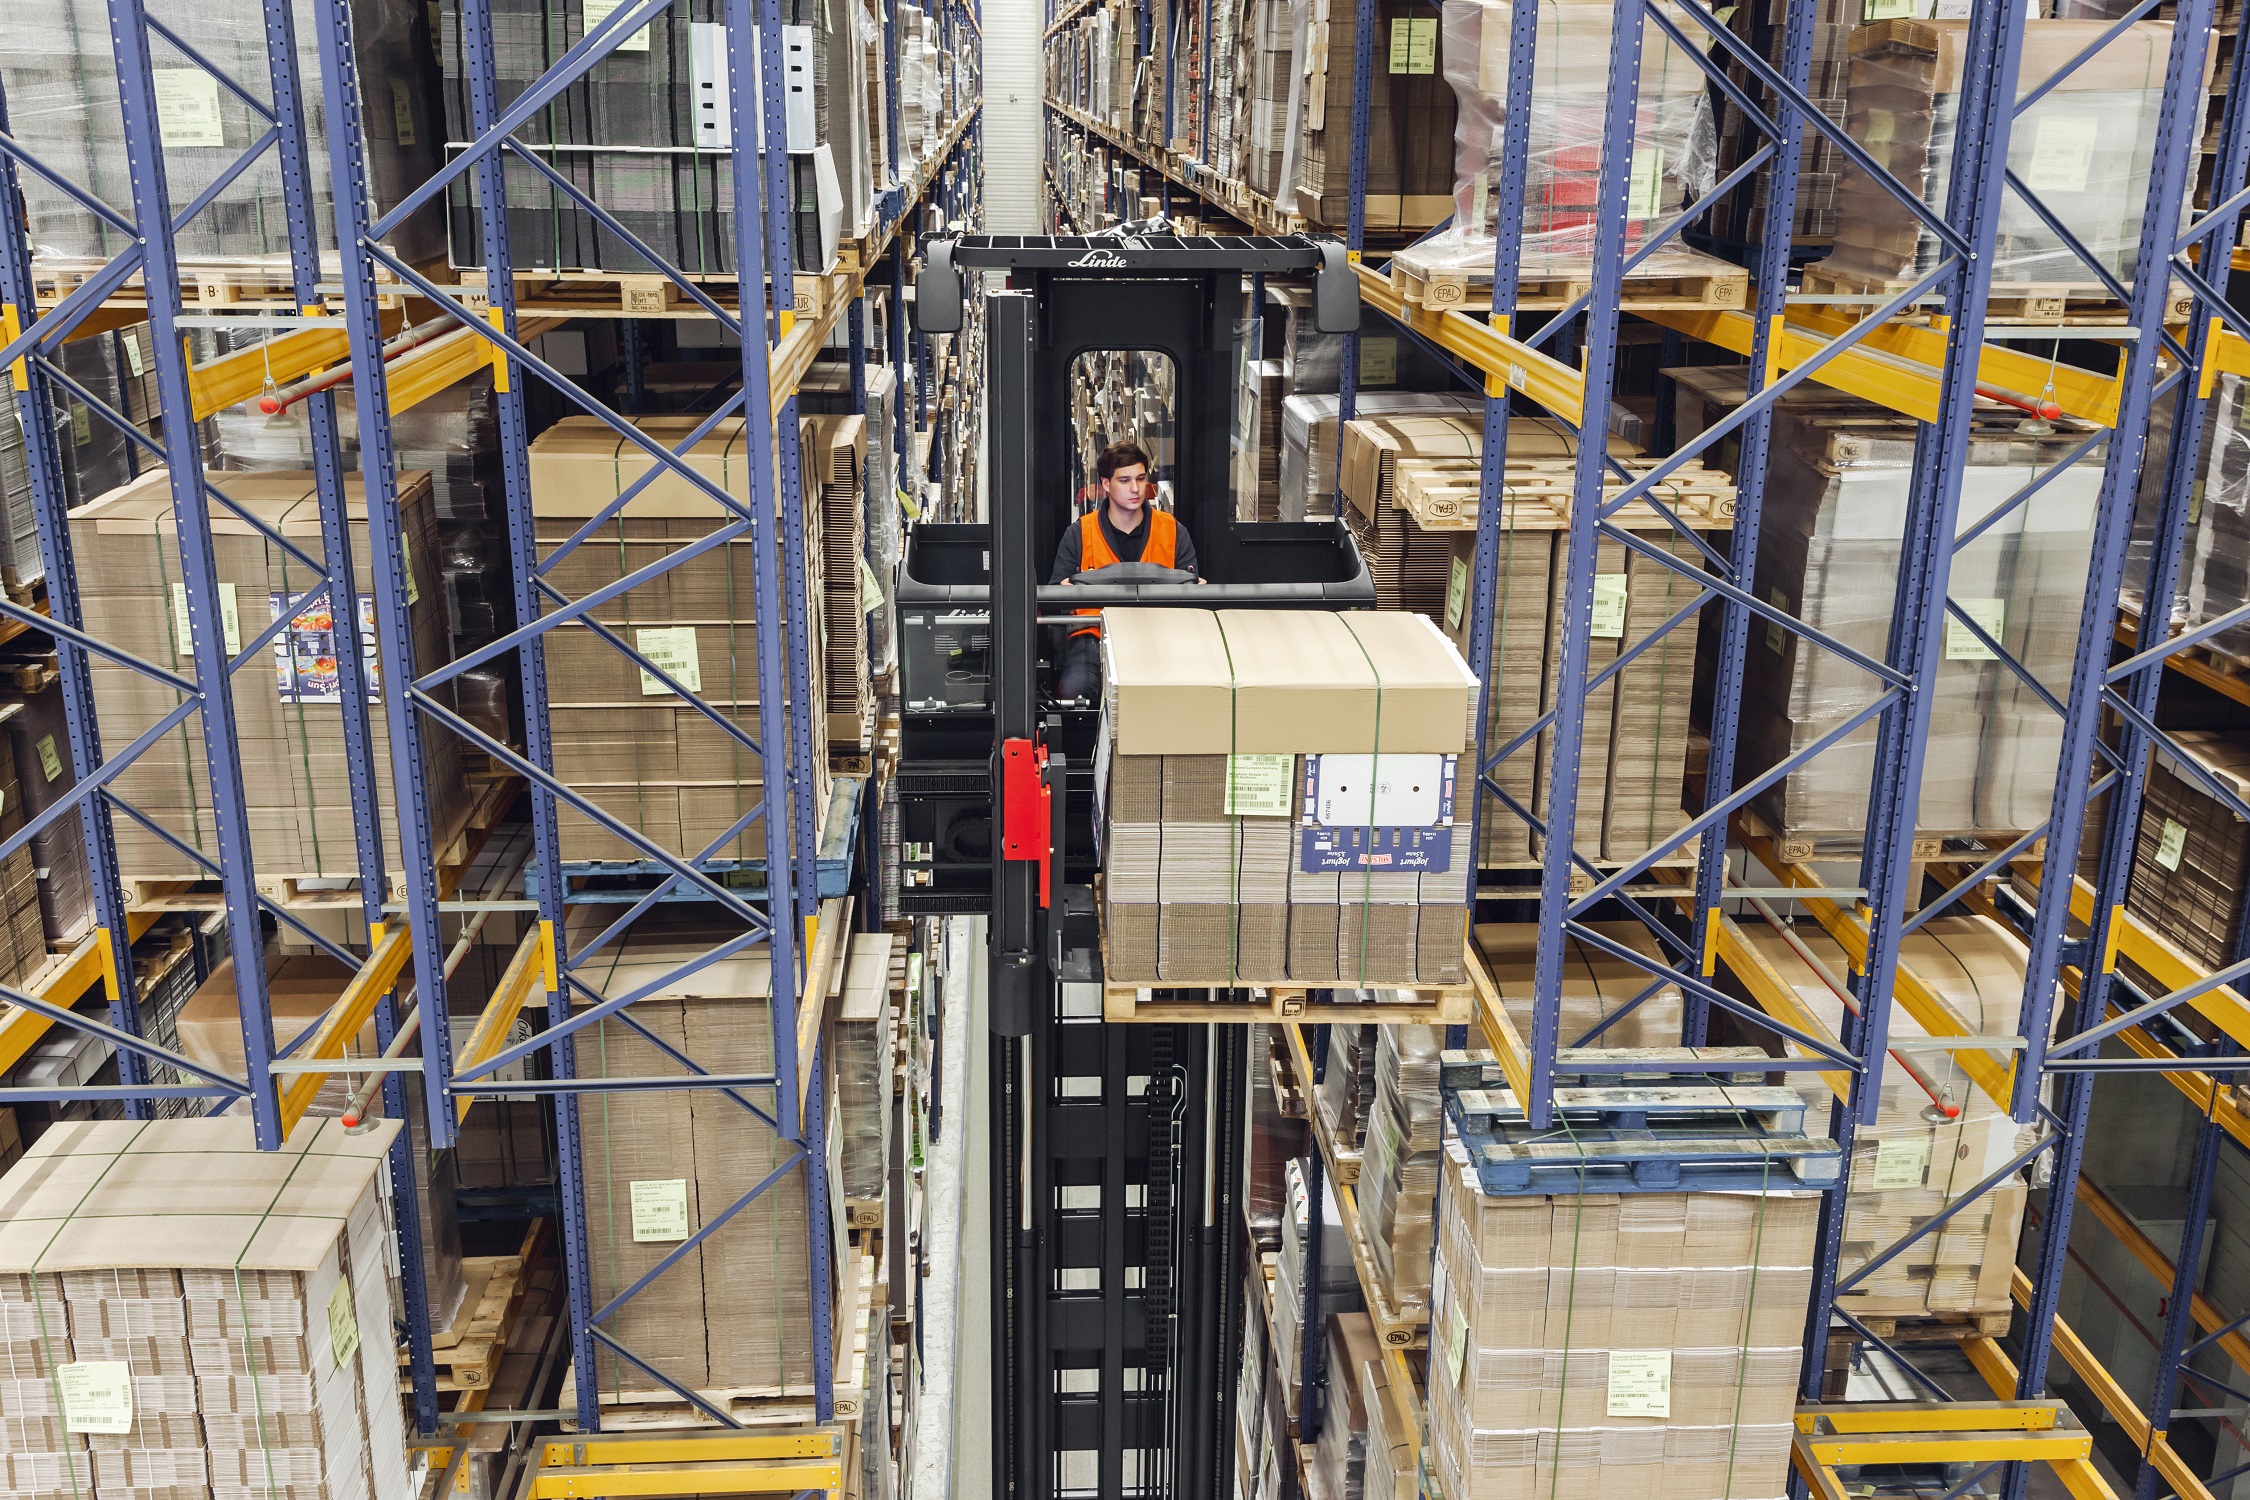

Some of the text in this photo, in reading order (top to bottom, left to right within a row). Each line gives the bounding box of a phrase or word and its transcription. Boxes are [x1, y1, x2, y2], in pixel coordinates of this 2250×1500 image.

[1067, 249, 1127, 268] Linde
[1437, 288, 1458, 298] EPAL
[794, 294, 809, 308] EUR
[1434, 504, 1454, 514] EPAL
[1788, 846, 1806, 854] EPAL
[1322, 857, 1352, 866] Joghurt
[1400, 857, 1429, 866] Joghurt
[834, 1404, 853, 1412] EPAL
